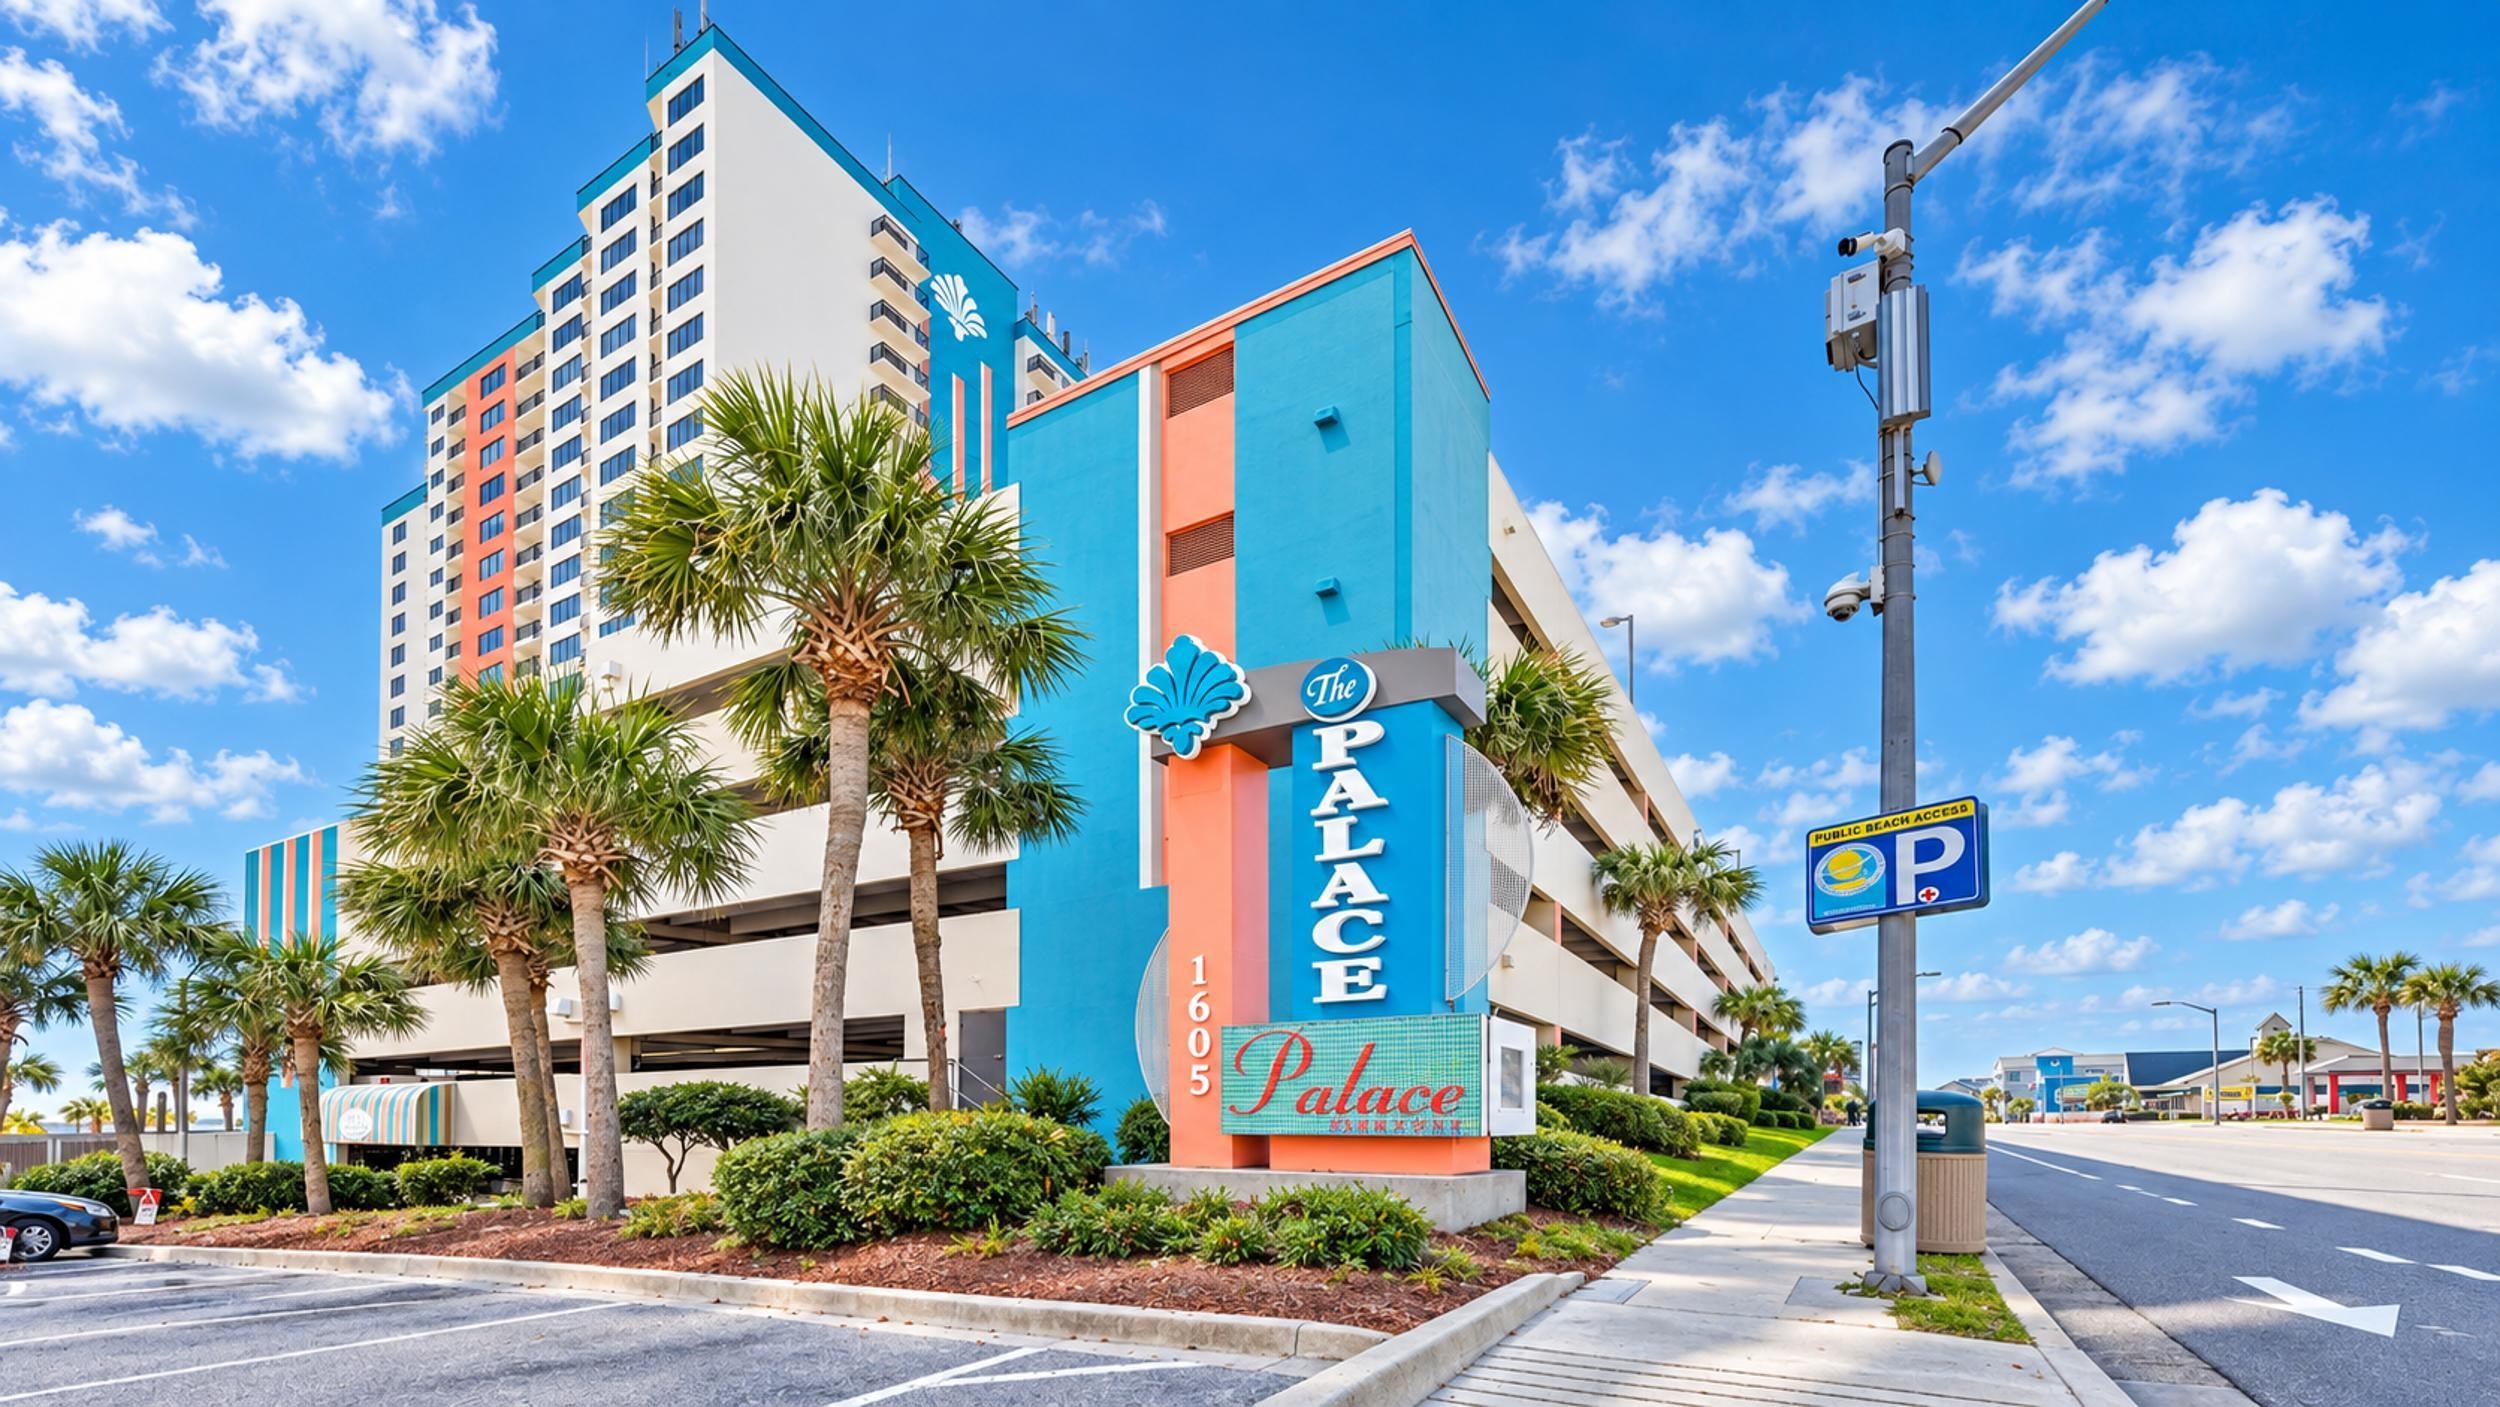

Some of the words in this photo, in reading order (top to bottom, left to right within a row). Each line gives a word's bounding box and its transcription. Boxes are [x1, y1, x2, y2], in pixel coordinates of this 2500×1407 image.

[1306, 663, 1357, 708] The
[1311, 719, 1389, 1004] PALACE
[1815, 825, 1861, 844] PUBLIC
[1865, 816, 1911, 834] BEACH
[1914, 803, 1969, 823] ACCESS
[1895, 825, 1966, 906] P
[1187, 954, 1213, 1096] 1605
[1229, 1027, 1466, 1115] Palace
